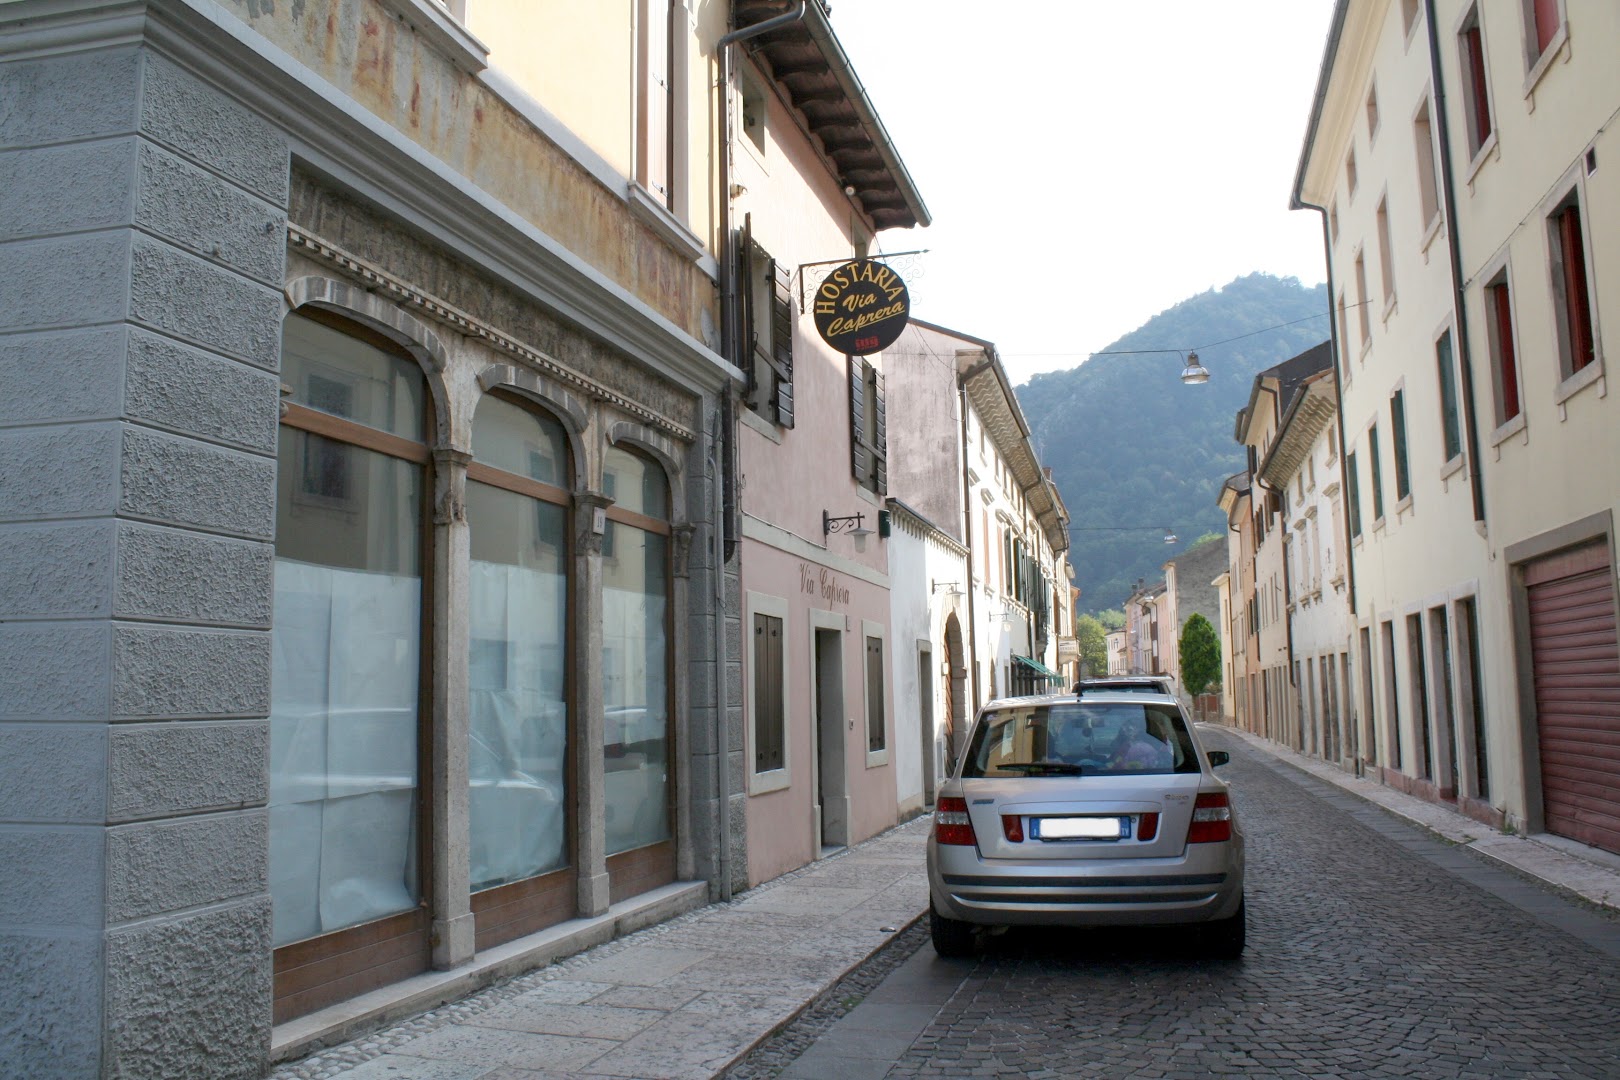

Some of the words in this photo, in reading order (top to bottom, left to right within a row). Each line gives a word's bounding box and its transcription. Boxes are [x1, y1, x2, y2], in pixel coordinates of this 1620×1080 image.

[816, 262, 905, 314] HOSTARIA
[842, 293, 878, 312] Via
[826, 301, 906, 337] Caprera
[800, 562, 815, 595] Via
